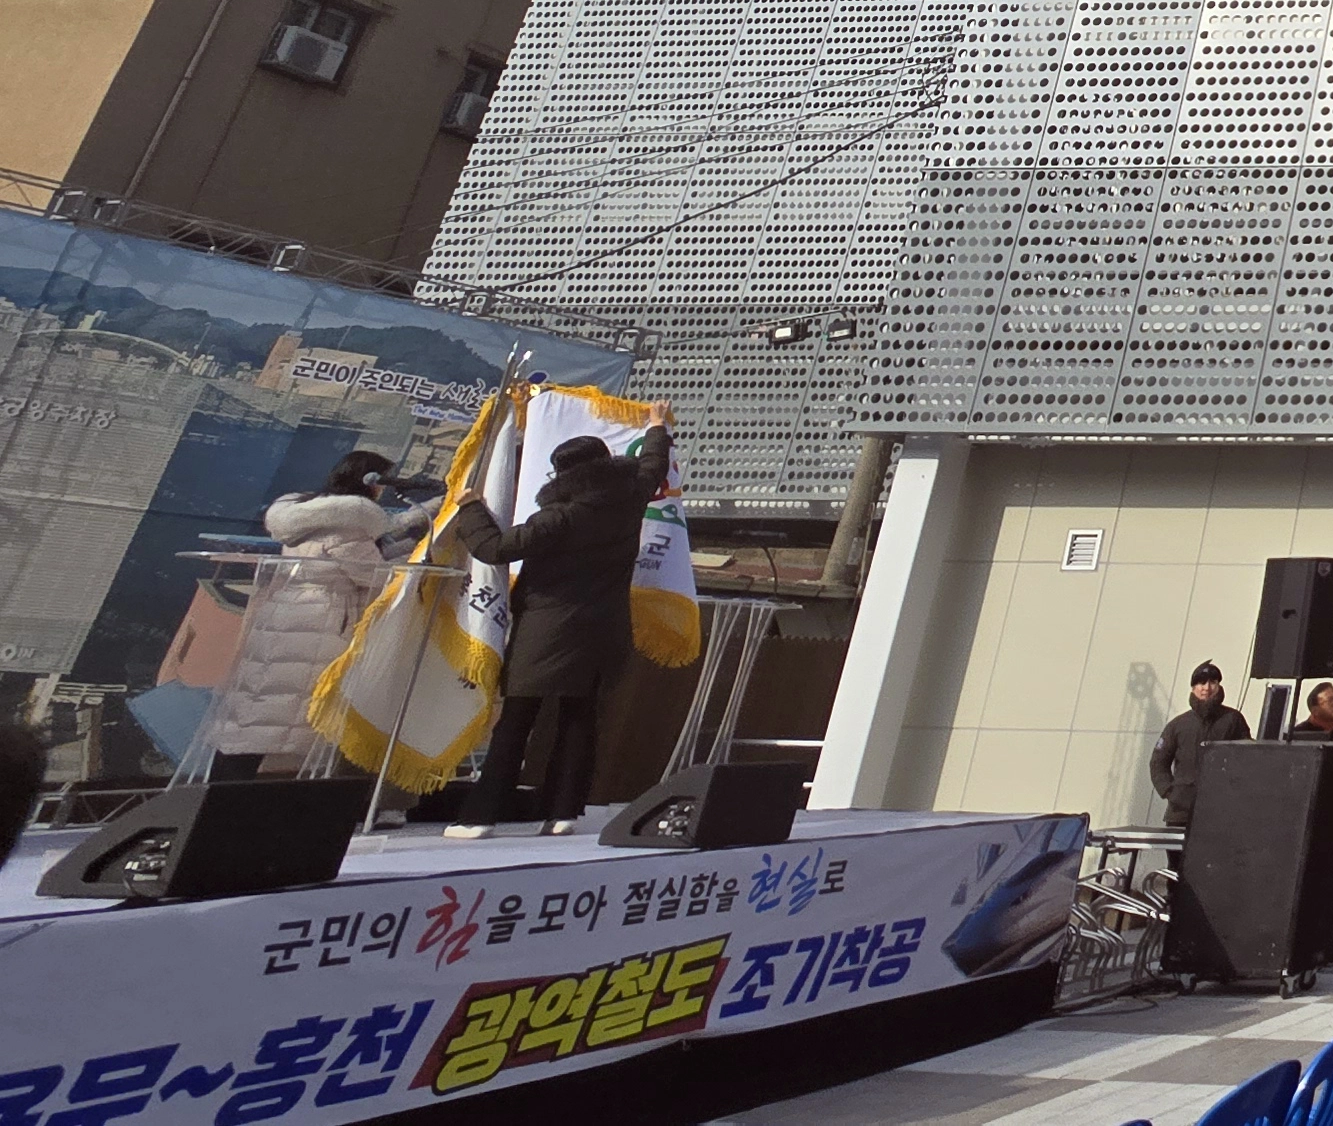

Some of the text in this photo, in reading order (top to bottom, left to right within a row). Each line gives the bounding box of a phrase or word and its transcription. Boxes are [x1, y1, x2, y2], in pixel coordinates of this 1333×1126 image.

[292, 358, 358, 384] 군민이
[358, 368, 435, 399] 주인되는
[264, 847, 849, 976] 군민의 힘을 모아 절실함을 현실로
[434, 933, 728, 1096] 광역철도
[717, 917, 927, 1018] 조기착공
